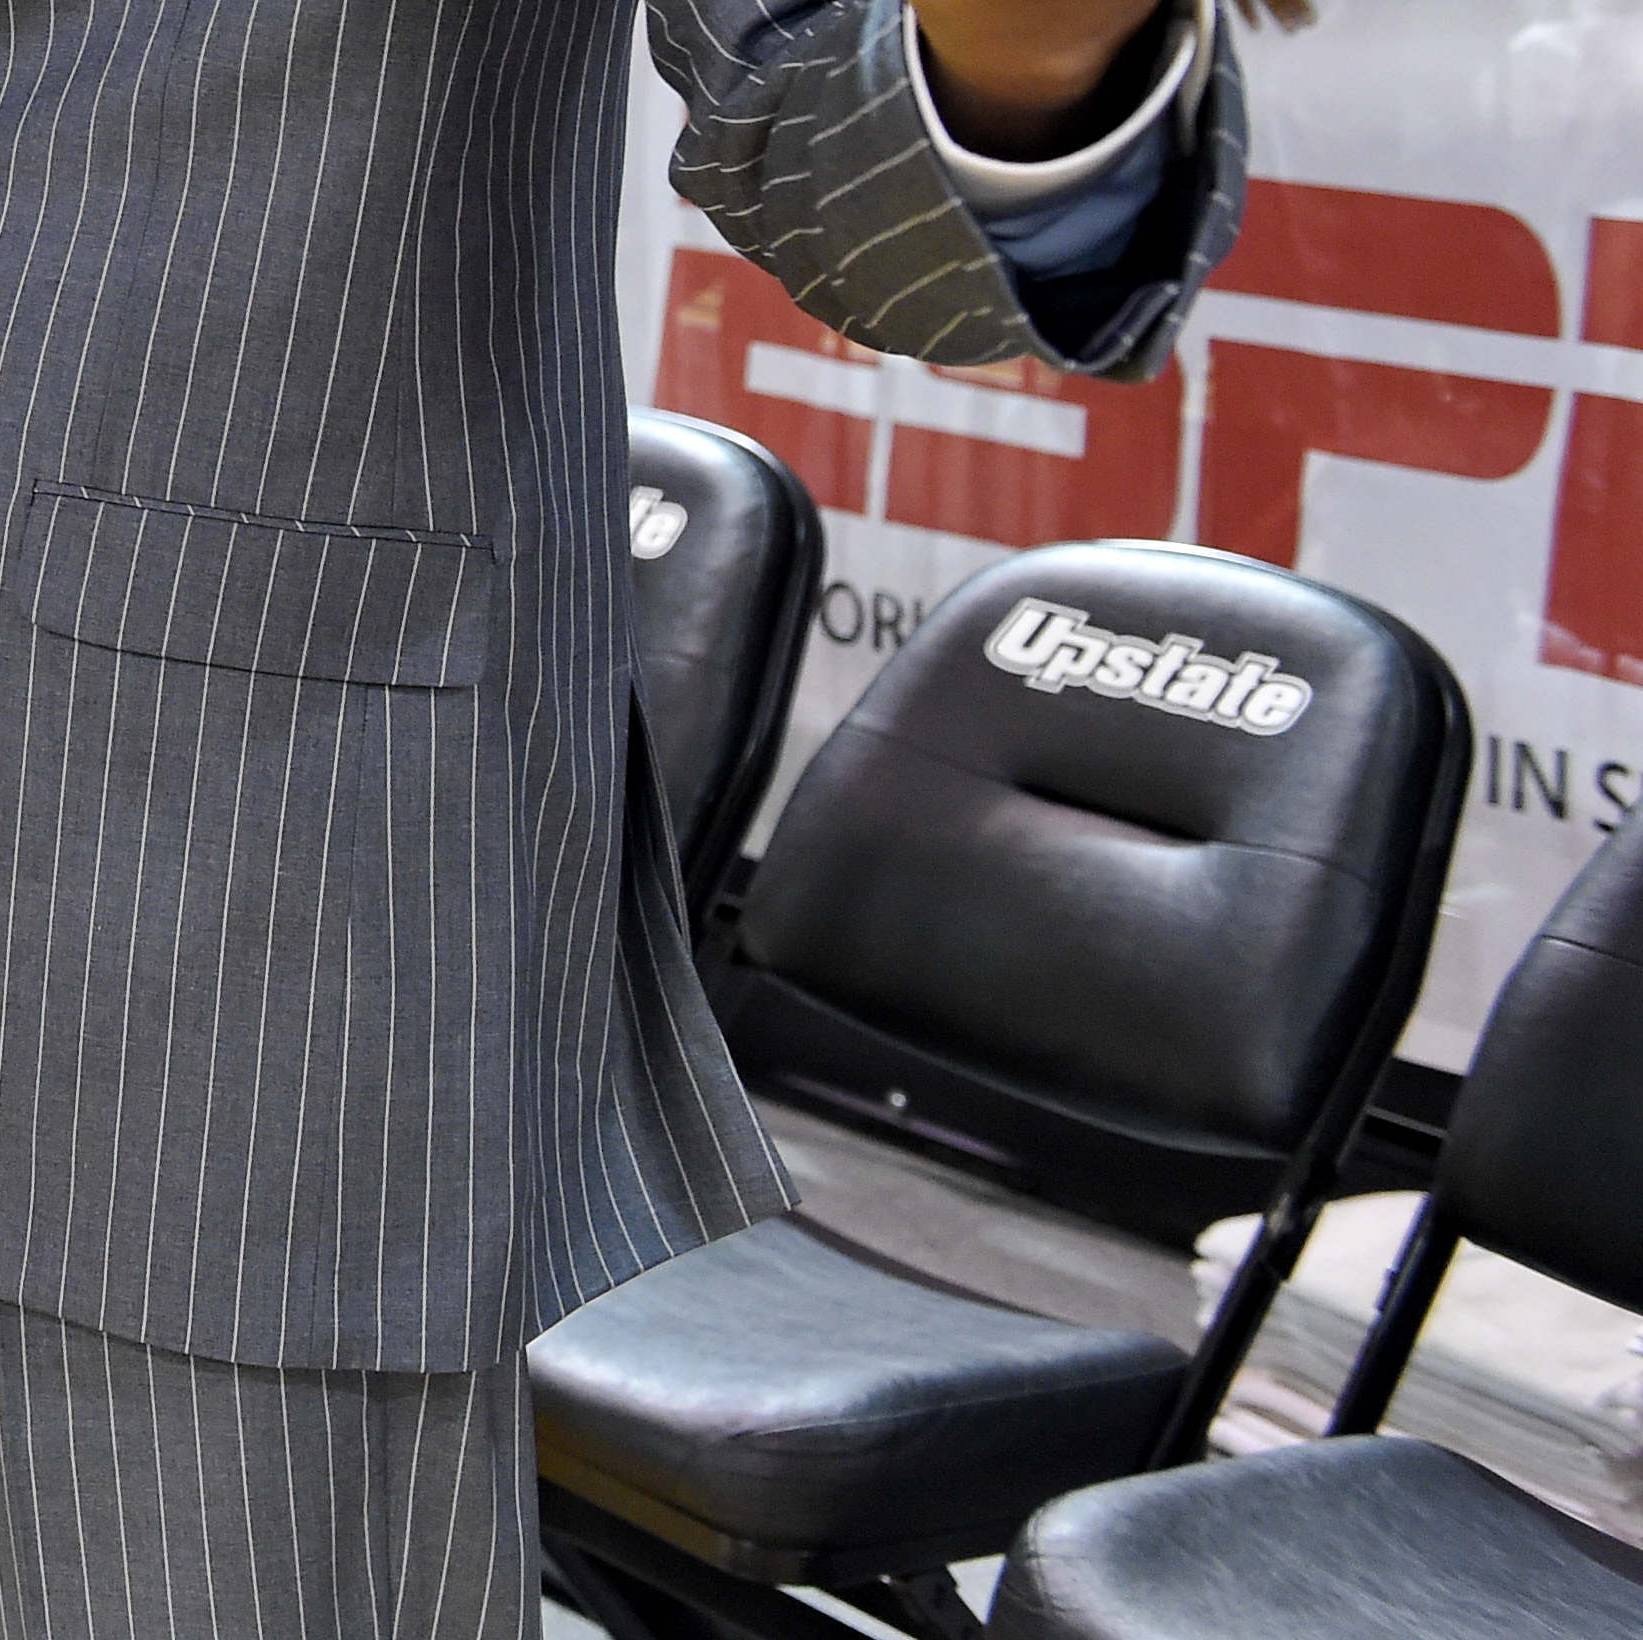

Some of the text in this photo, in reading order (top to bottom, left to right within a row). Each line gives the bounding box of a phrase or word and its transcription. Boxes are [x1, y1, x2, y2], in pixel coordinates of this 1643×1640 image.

[653, 115, 1643, 688] ESP
[984, 596, 1313, 737] Upstate
[1487, 734, 1569, 820] IN
